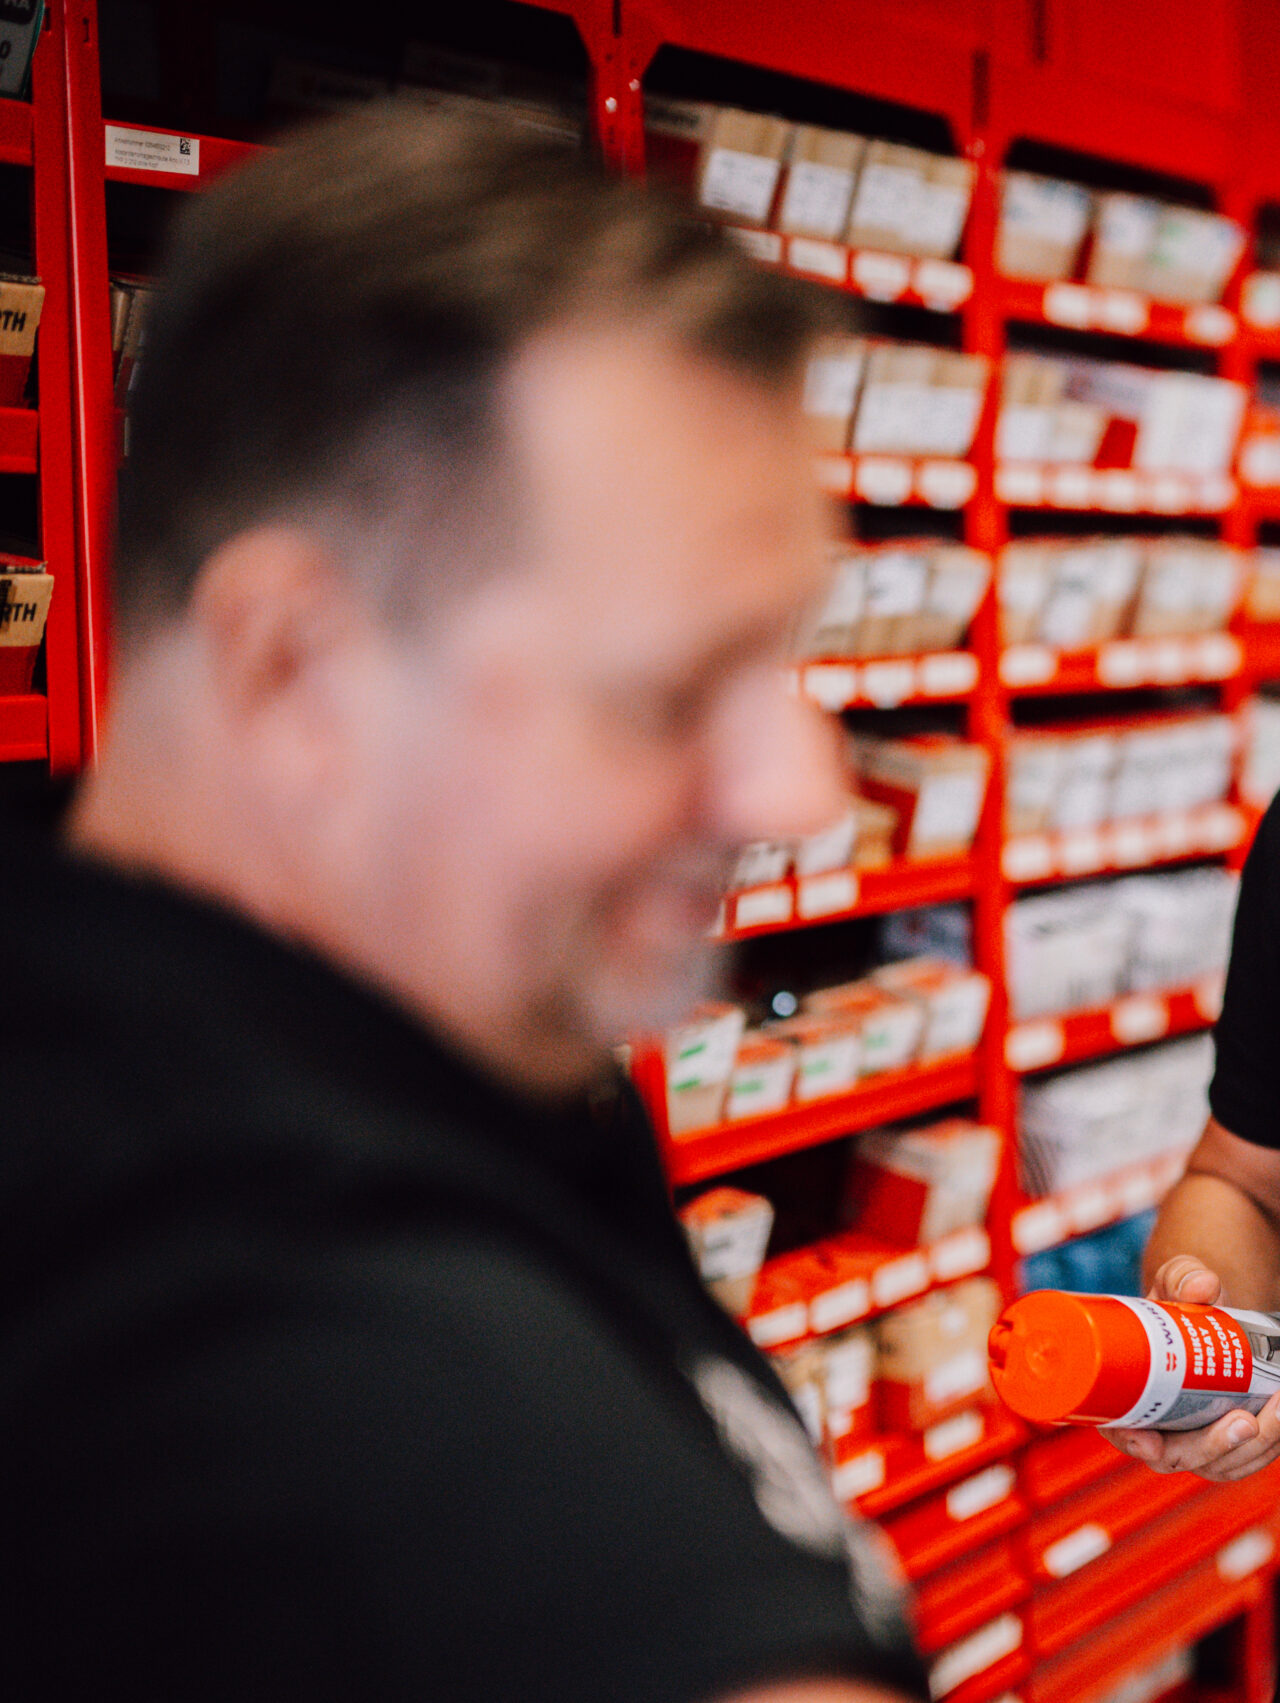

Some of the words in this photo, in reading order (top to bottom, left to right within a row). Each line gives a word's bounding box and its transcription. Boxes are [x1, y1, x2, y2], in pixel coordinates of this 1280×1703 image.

[0, 310, 26, 332] TH
[1198, 1327, 1217, 1377] SPRAY
[1205, 1315, 1232, 1378] SILICONE
[1227, 1329, 1245, 1379] SPRAY
